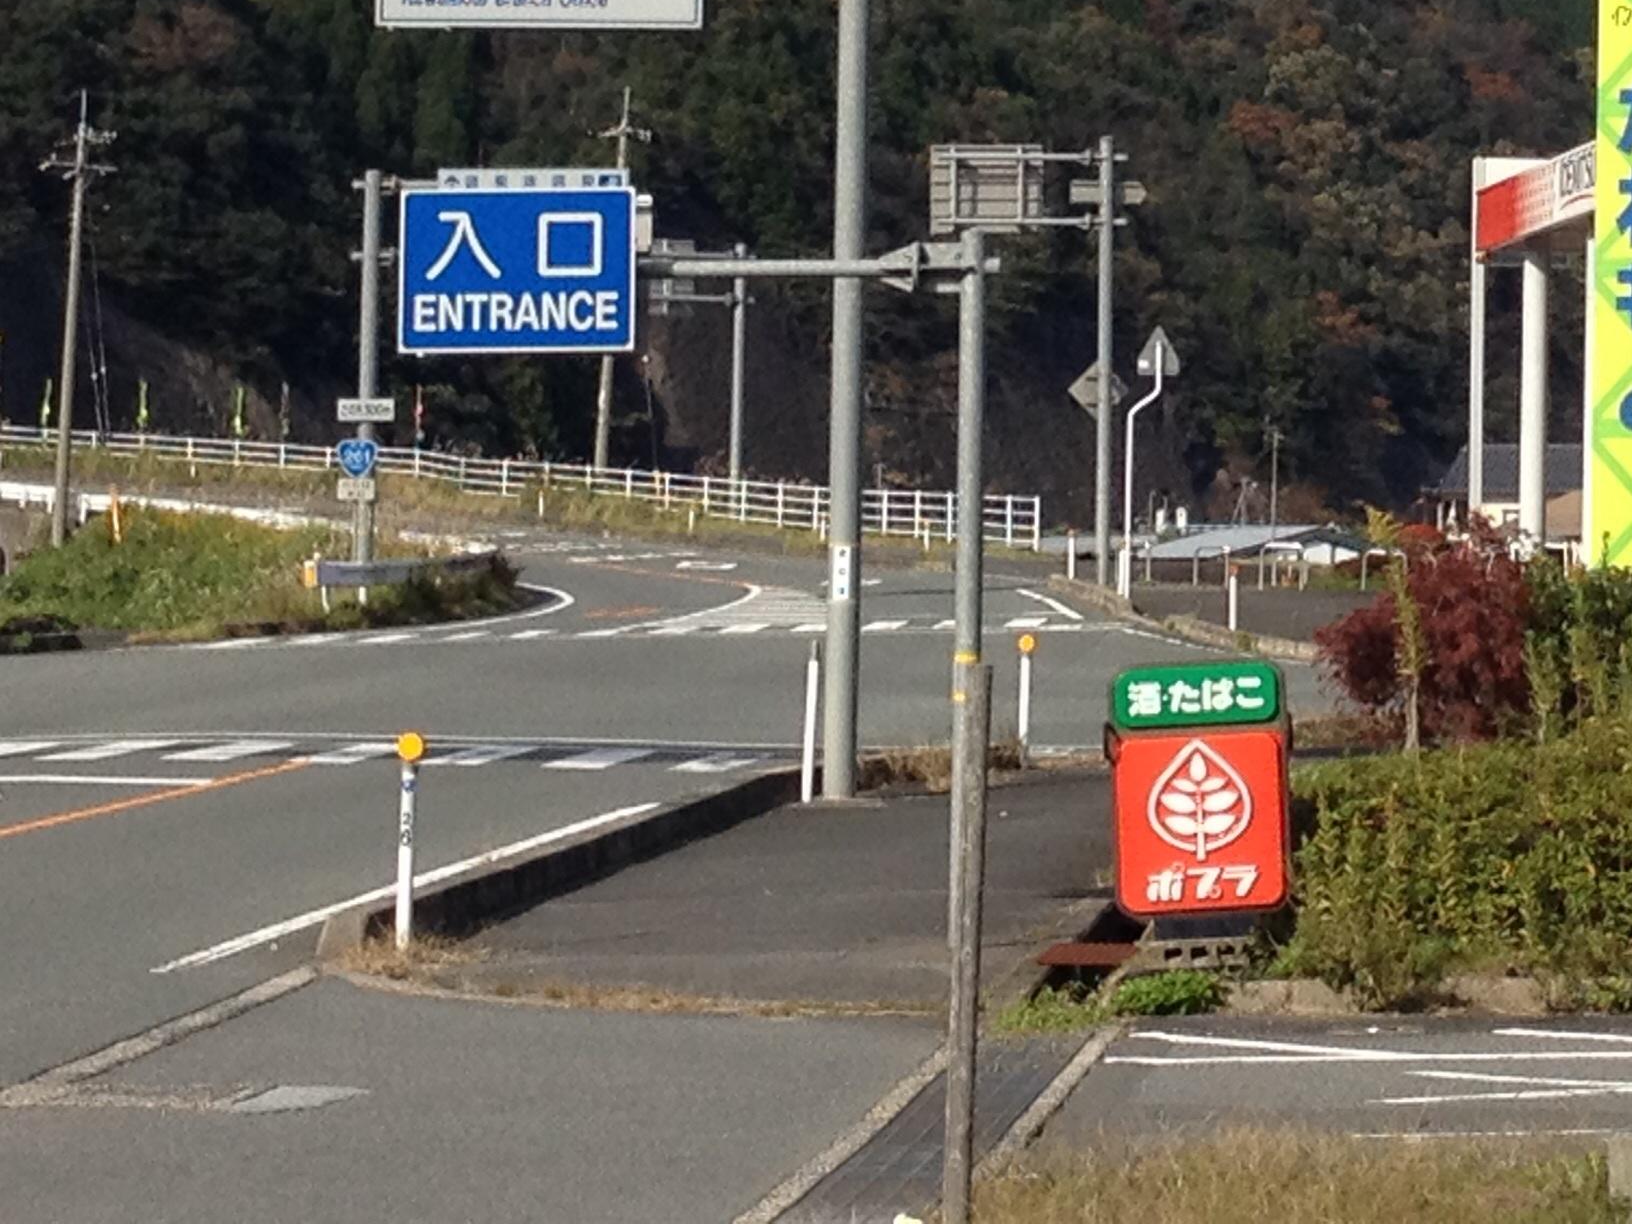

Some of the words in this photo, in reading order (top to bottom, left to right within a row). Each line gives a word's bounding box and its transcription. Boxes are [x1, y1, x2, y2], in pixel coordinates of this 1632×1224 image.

[425, 210, 602, 281] 入口
[413, 290, 619, 333] ENTRANCE
[1146, 861, 1259, 902] ポプラ
